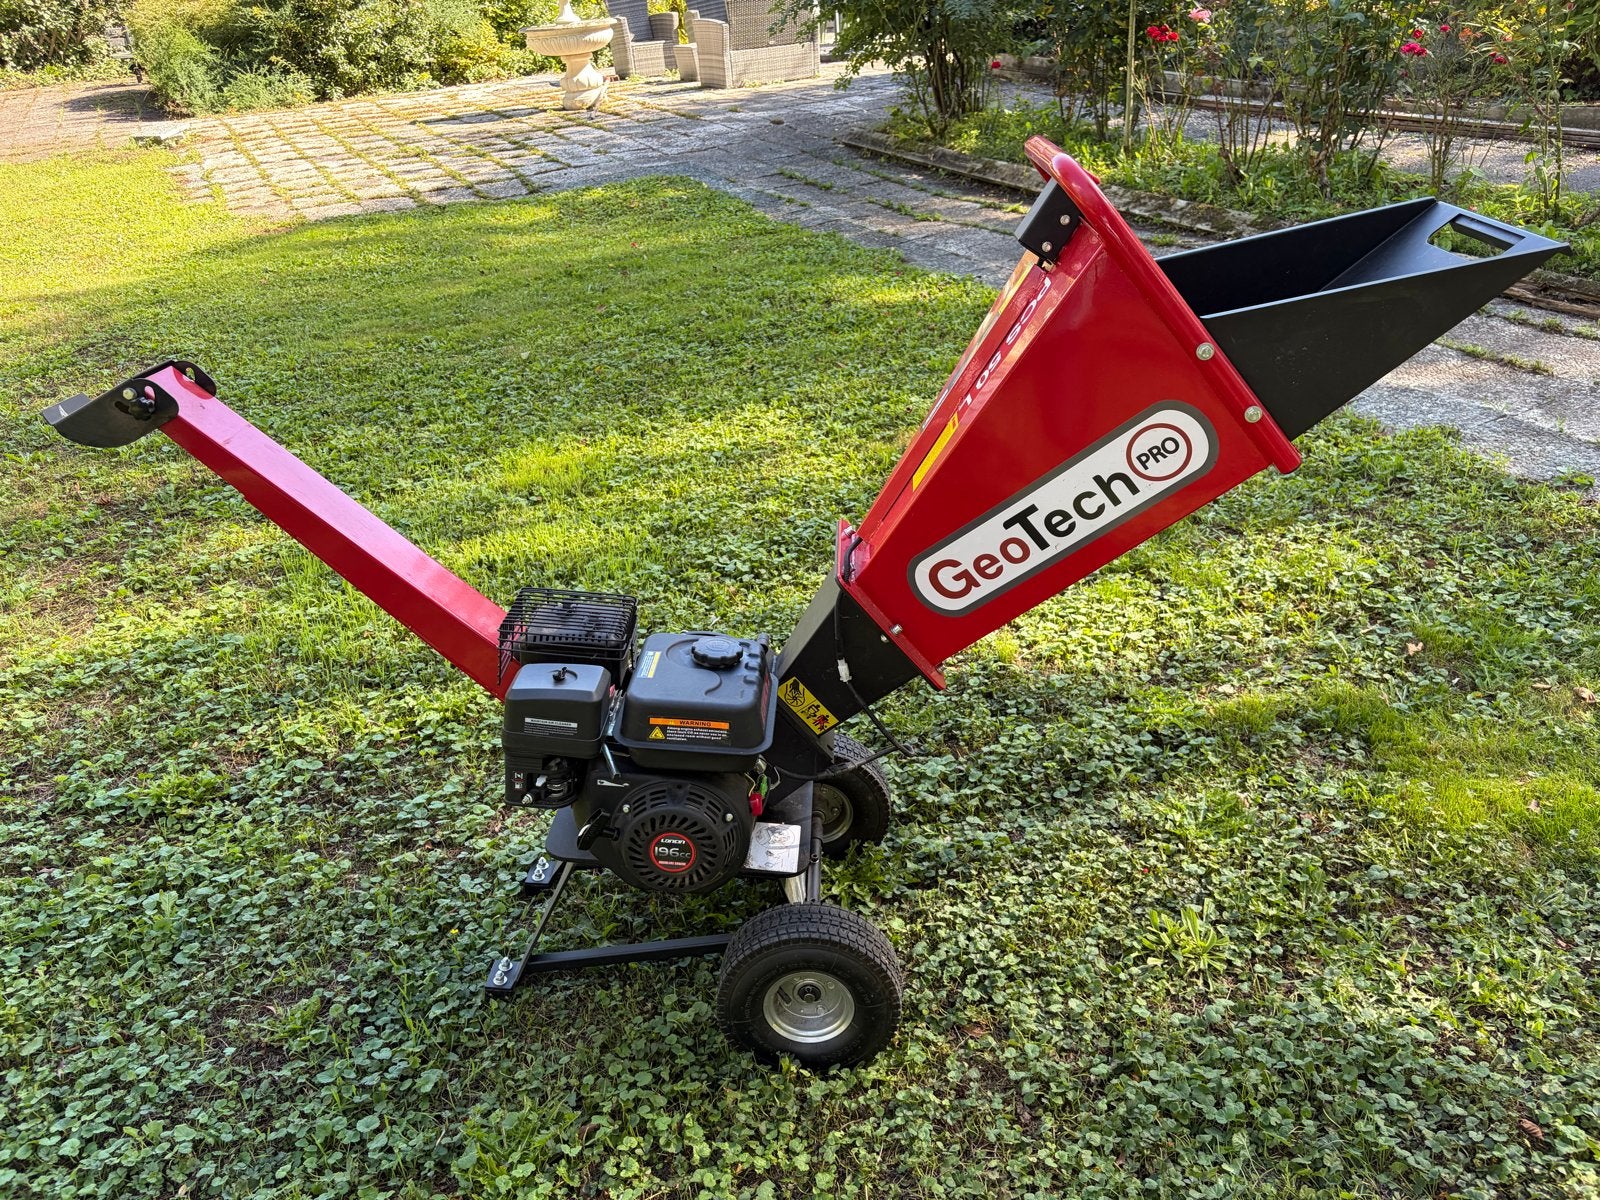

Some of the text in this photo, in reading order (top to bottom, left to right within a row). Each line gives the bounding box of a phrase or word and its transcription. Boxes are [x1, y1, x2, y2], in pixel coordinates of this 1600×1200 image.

[1006, 277, 1051, 346] PCS
[1136, 437, 1180, 470] PRO
[928, 472, 1140, 599] GeoTech
